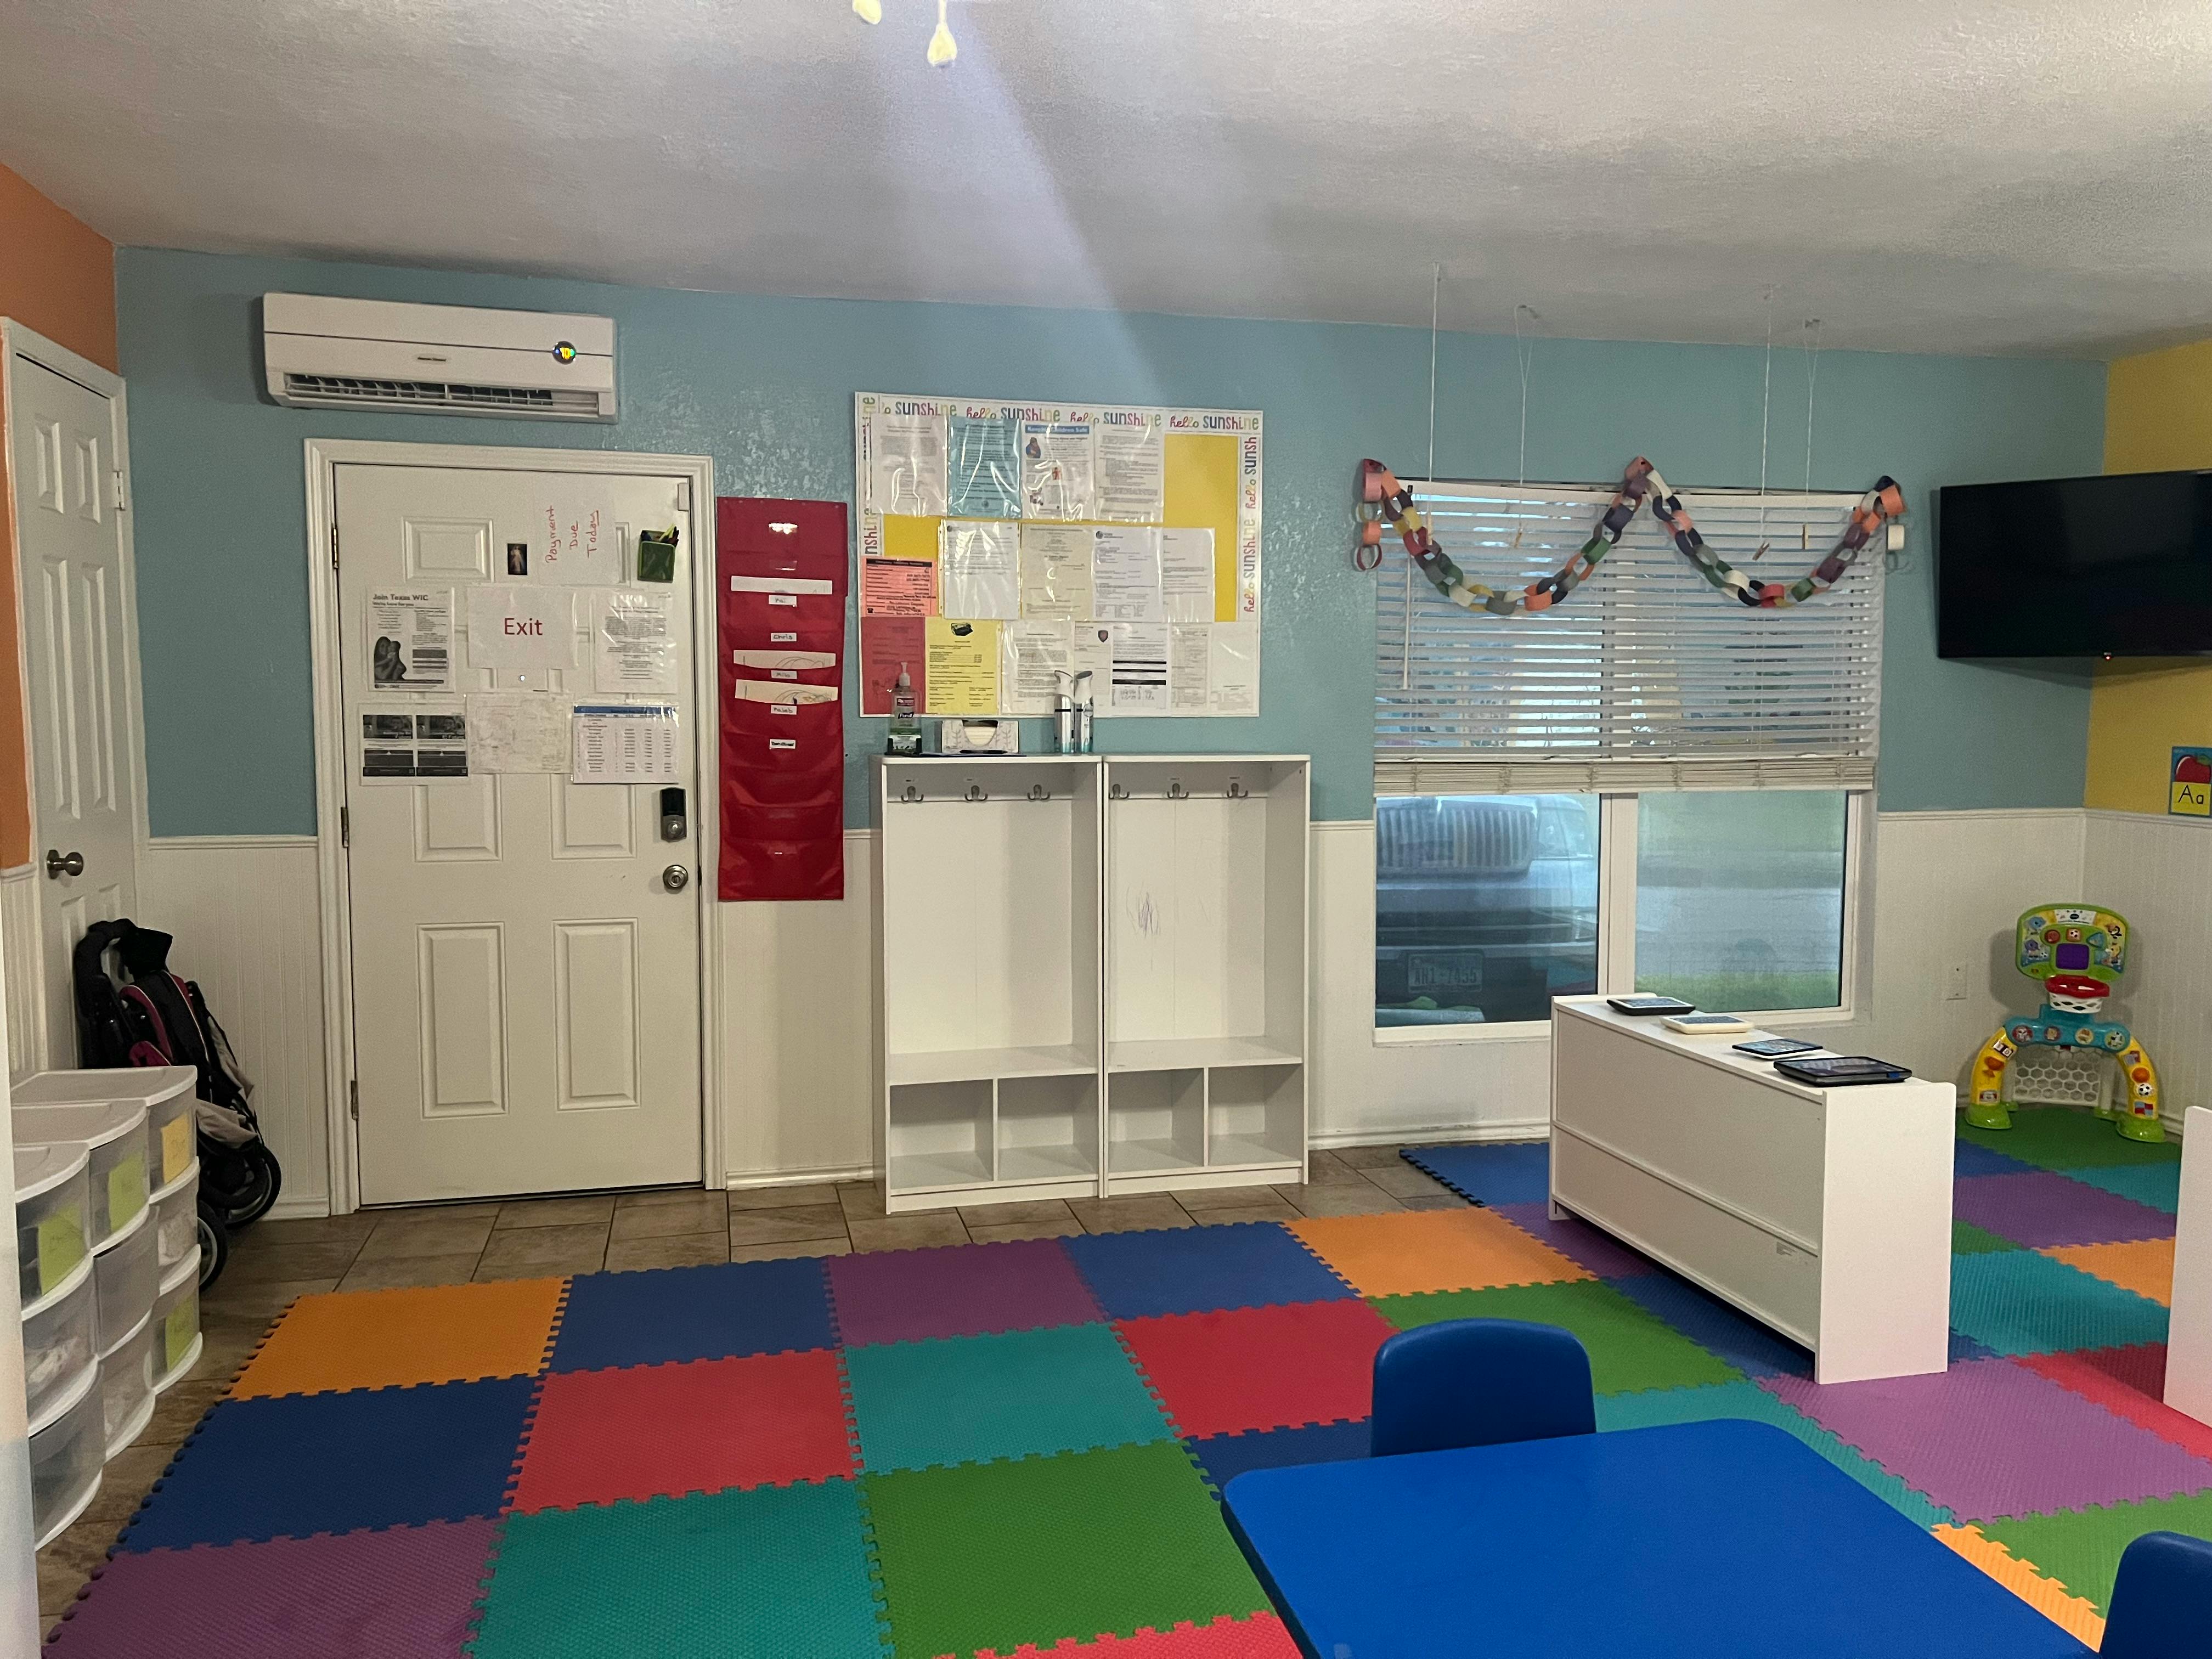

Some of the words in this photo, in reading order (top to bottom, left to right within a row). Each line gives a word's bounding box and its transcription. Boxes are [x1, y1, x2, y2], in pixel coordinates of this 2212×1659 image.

[895, 402, 957, 416] sunshine
[966, 407, 996, 420] hello
[1001, 407, 1060, 421] sunshine
[1070, 411, 1099, 425] hello
[1103, 412, 1161, 427] sunshine
[1170, 416, 1199, 428] hello
[1203, 415, 1259, 430] sunshine
[1245, 479, 1256, 509] hello
[545, 505, 561, 563] Payment
[569, 520, 579, 550] Due
[585, 510, 600, 558] Today
[1243, 518, 1256, 579] sunshine
[1244, 582, 1255, 612] hello
[504, 618, 543, 635] Exit
